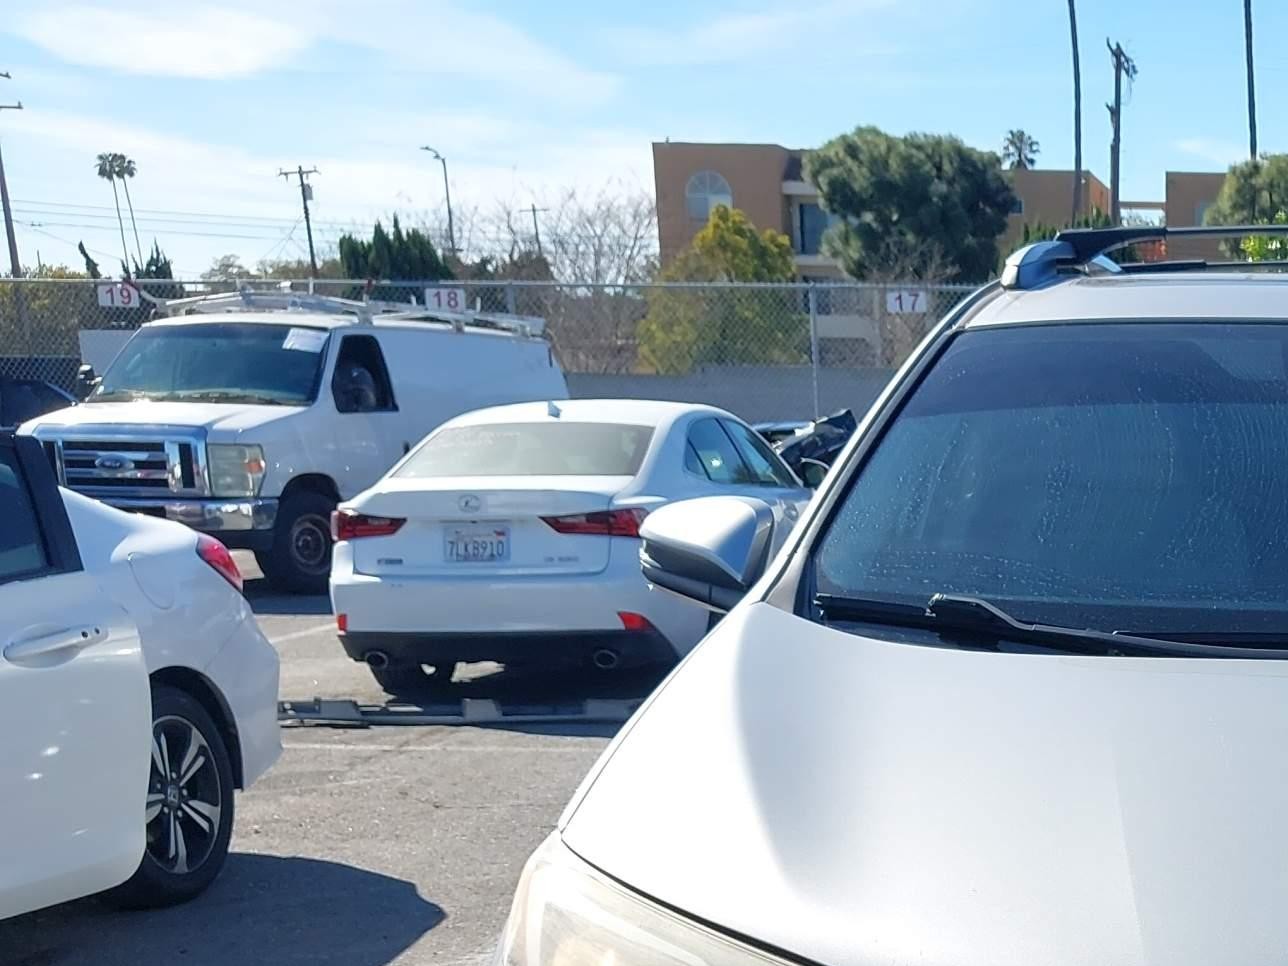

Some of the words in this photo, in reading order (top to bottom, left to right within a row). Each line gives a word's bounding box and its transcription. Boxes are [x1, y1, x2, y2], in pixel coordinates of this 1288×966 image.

[105, 287, 132, 305] 19
[432, 290, 459, 309] 18
[895, 293, 919, 312] 17
